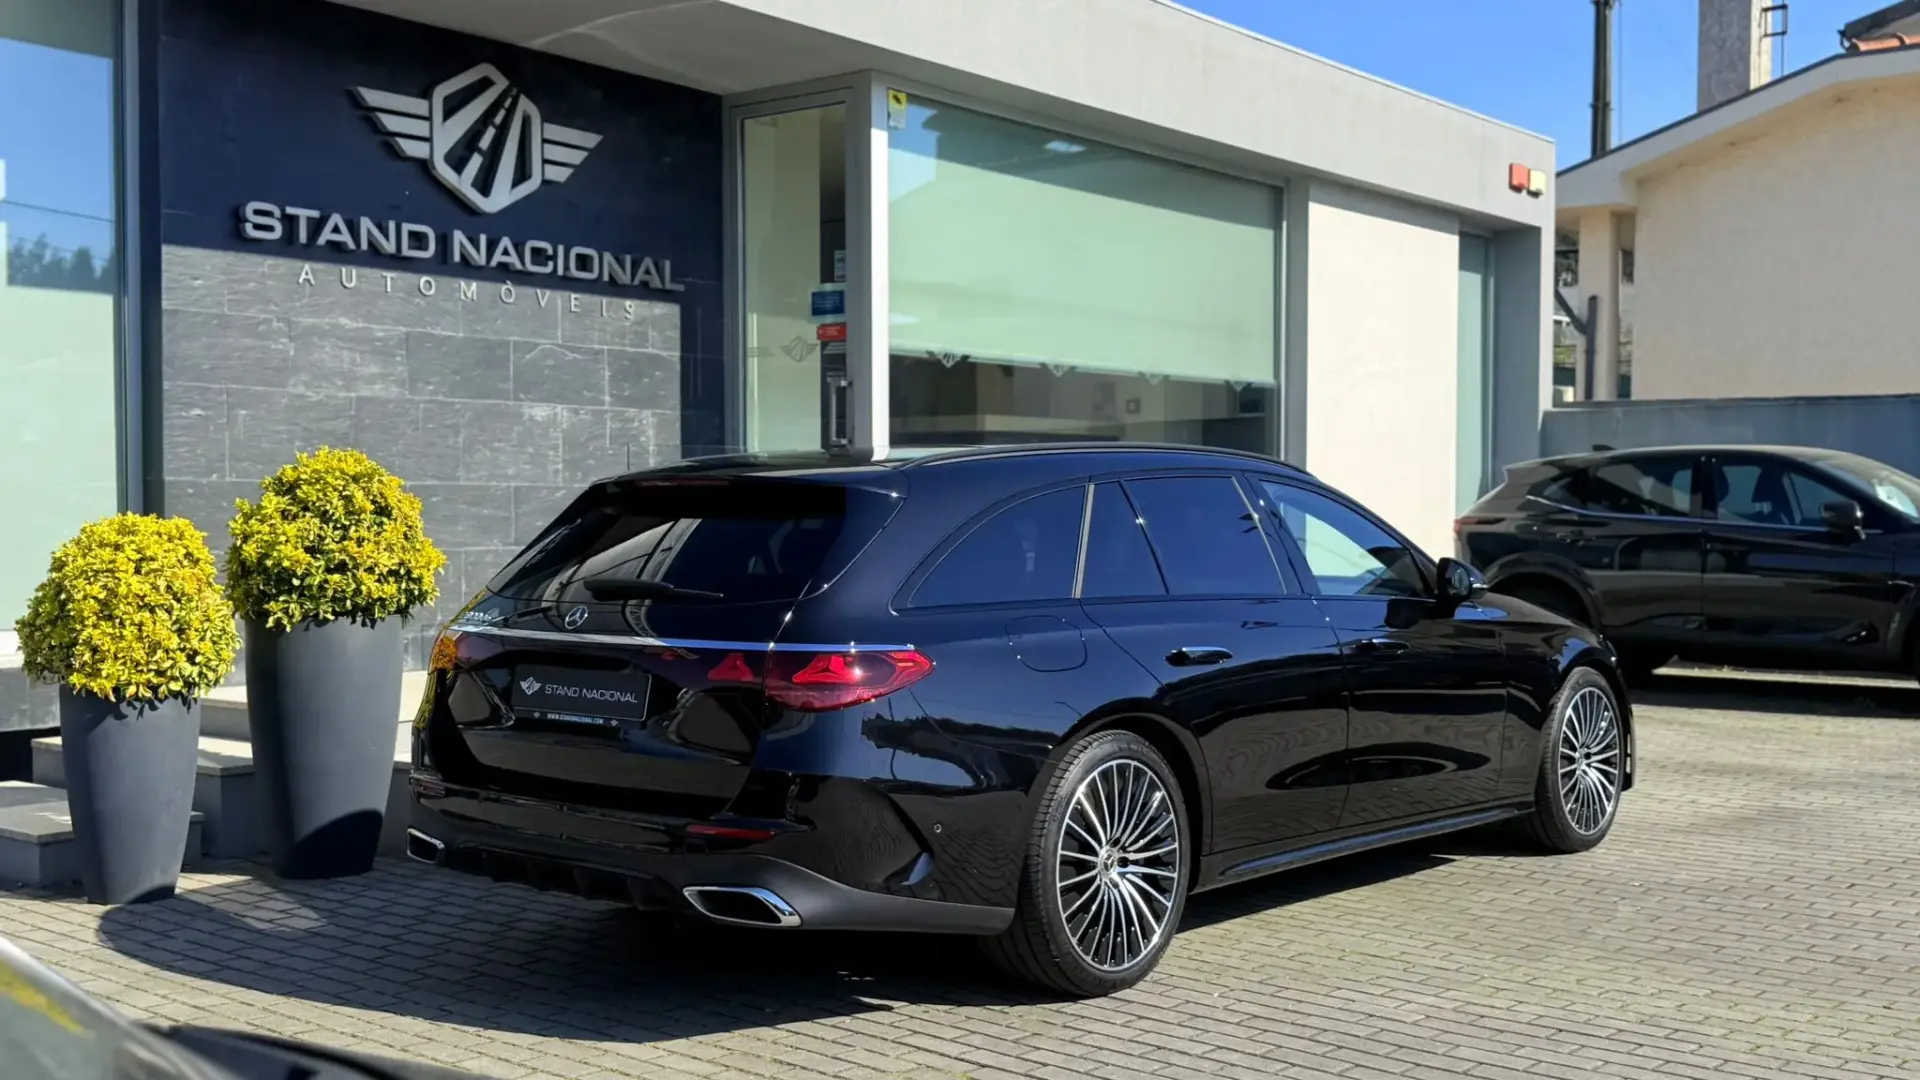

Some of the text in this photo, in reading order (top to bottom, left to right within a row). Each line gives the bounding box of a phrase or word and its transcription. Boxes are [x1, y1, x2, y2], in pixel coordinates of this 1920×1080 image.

[243, 200, 685, 292] STAND NACIONAL
[544, 684, 638, 703] STAND NACIONAL
